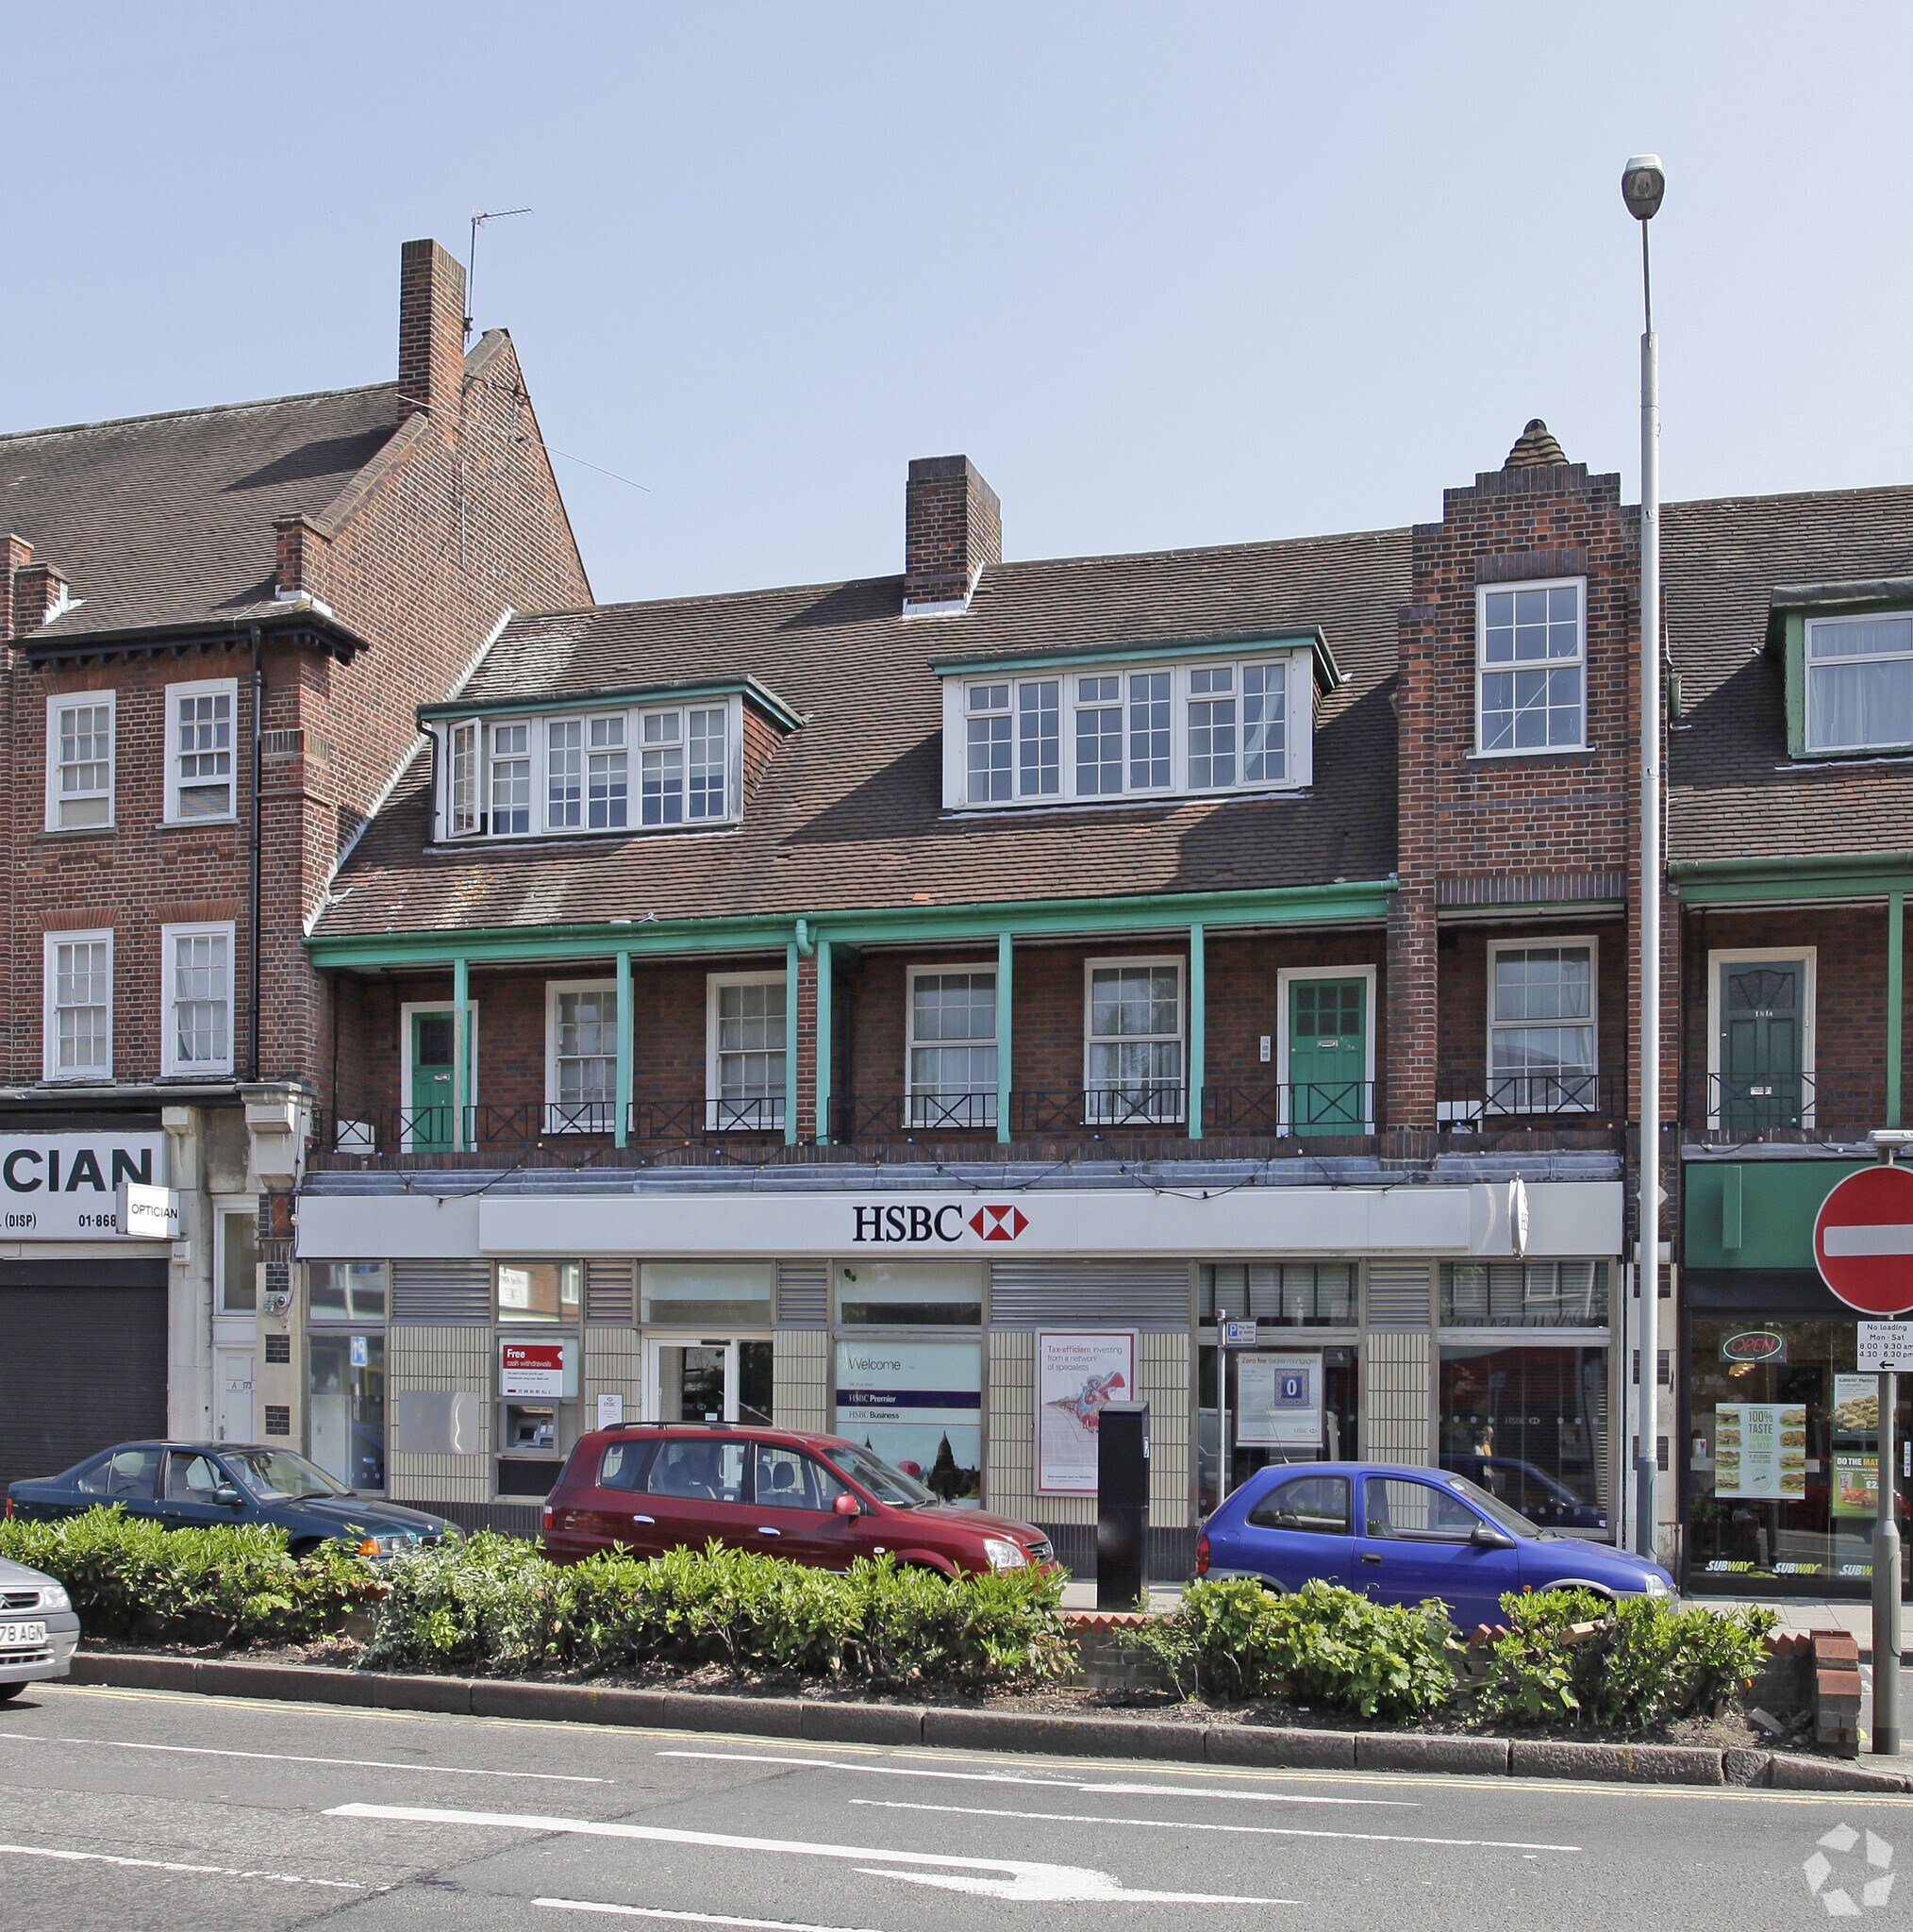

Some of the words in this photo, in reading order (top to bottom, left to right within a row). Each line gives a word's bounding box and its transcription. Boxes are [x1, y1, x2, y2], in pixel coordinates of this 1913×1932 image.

[131, 1204, 178, 1219] OPTICIAN
[5, 1211, 37, 1230] (DISP)
[853, 1205, 963, 1242] HSBC
[1230, 1324, 1236, 1335] P
[1093, 1346, 1123, 1355] investing
[1731, 1338, 1775, 1353] OPEN
[507, 1349, 525, 1358] Free
[849, 1358, 901, 1371] Welcome
[1287, 1379, 1298, 1396] 0
[1749, 1411, 1772, 1422] 100%
[1749, 1424, 1772, 1434] TASTE
[1837, 1457, 1847, 1465] DO
[1848, 1457, 1862, 1466] THE
[1705, 1561, 1755, 1572] SUBWAY
[1772, 1562, 1822, 1574] SUBWAY
[19, 1625, 44, 1641] AGN
